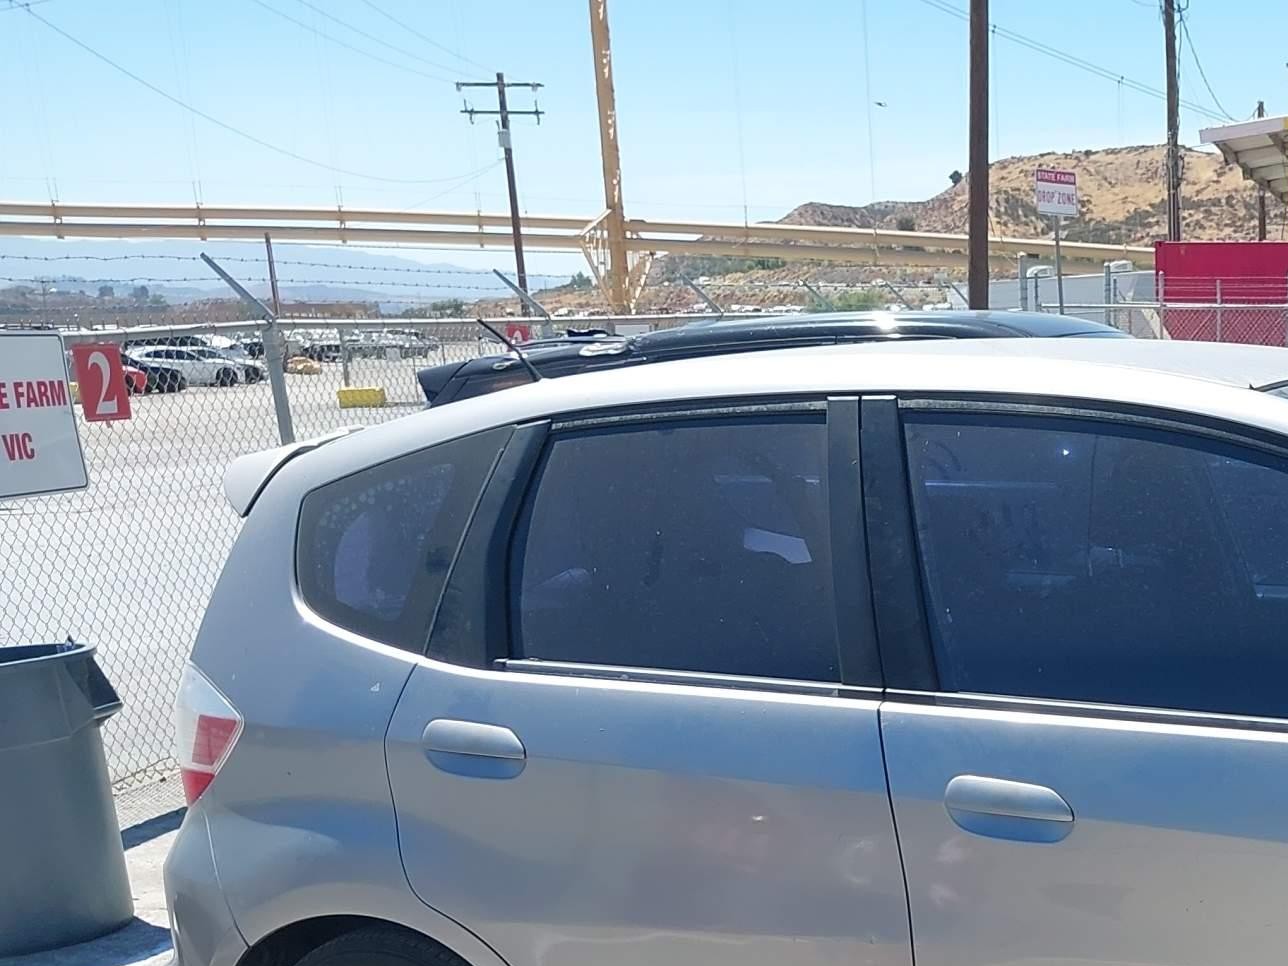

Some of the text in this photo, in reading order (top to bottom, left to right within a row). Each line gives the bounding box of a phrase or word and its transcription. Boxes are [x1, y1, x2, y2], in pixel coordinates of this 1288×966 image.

[13, 380, 67, 408] FARM
[87, 351, 118, 415] 2
[2, 432, 35, 461] VIC
